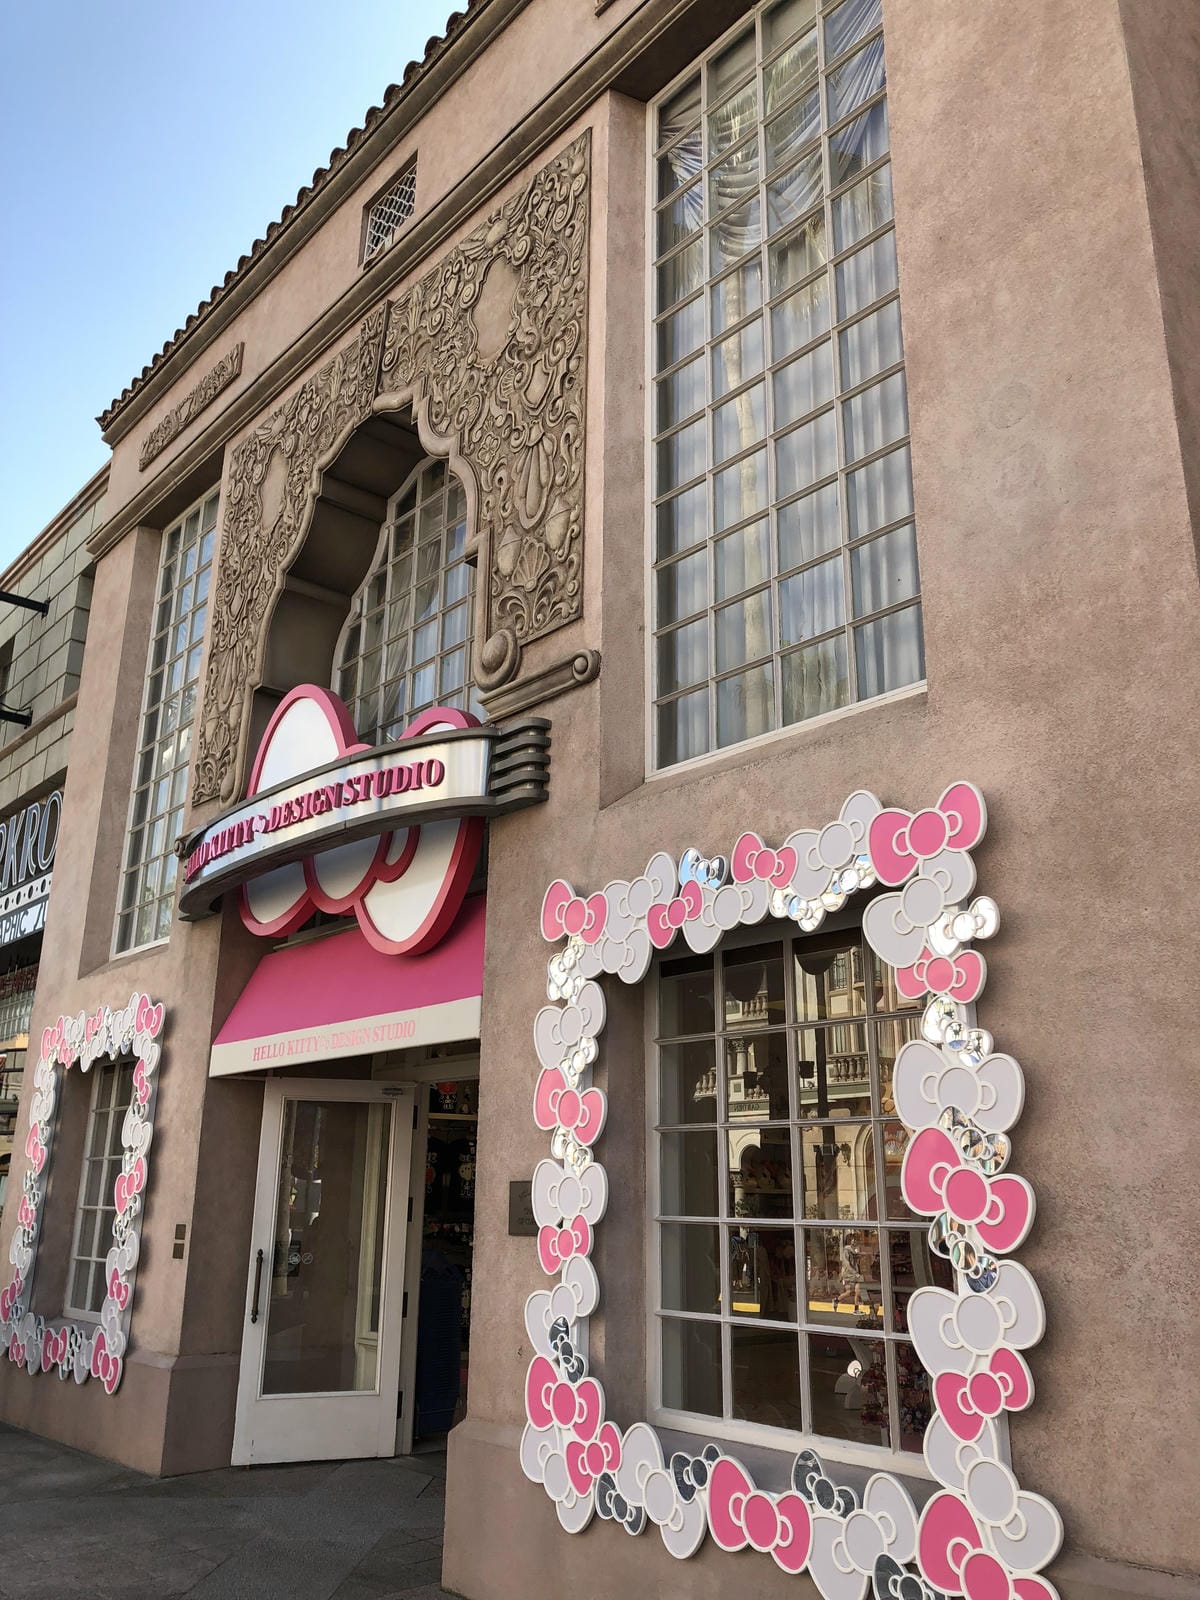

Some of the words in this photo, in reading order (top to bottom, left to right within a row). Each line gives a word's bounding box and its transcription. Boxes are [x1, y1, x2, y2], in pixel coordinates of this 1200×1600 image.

[208, 816, 254, 861] KITTY
[268, 782, 343, 833] DESIGN
[343, 758, 446, 806] STUDIO
[0, 908, 29, 944] PHIC
[252, 1041, 285, 1062] HELLO
[287, 1035, 321, 1056] KITTY
[331, 1027, 372, 1049] DESIGN
[372, 1020, 416, 1042] STUDIO
